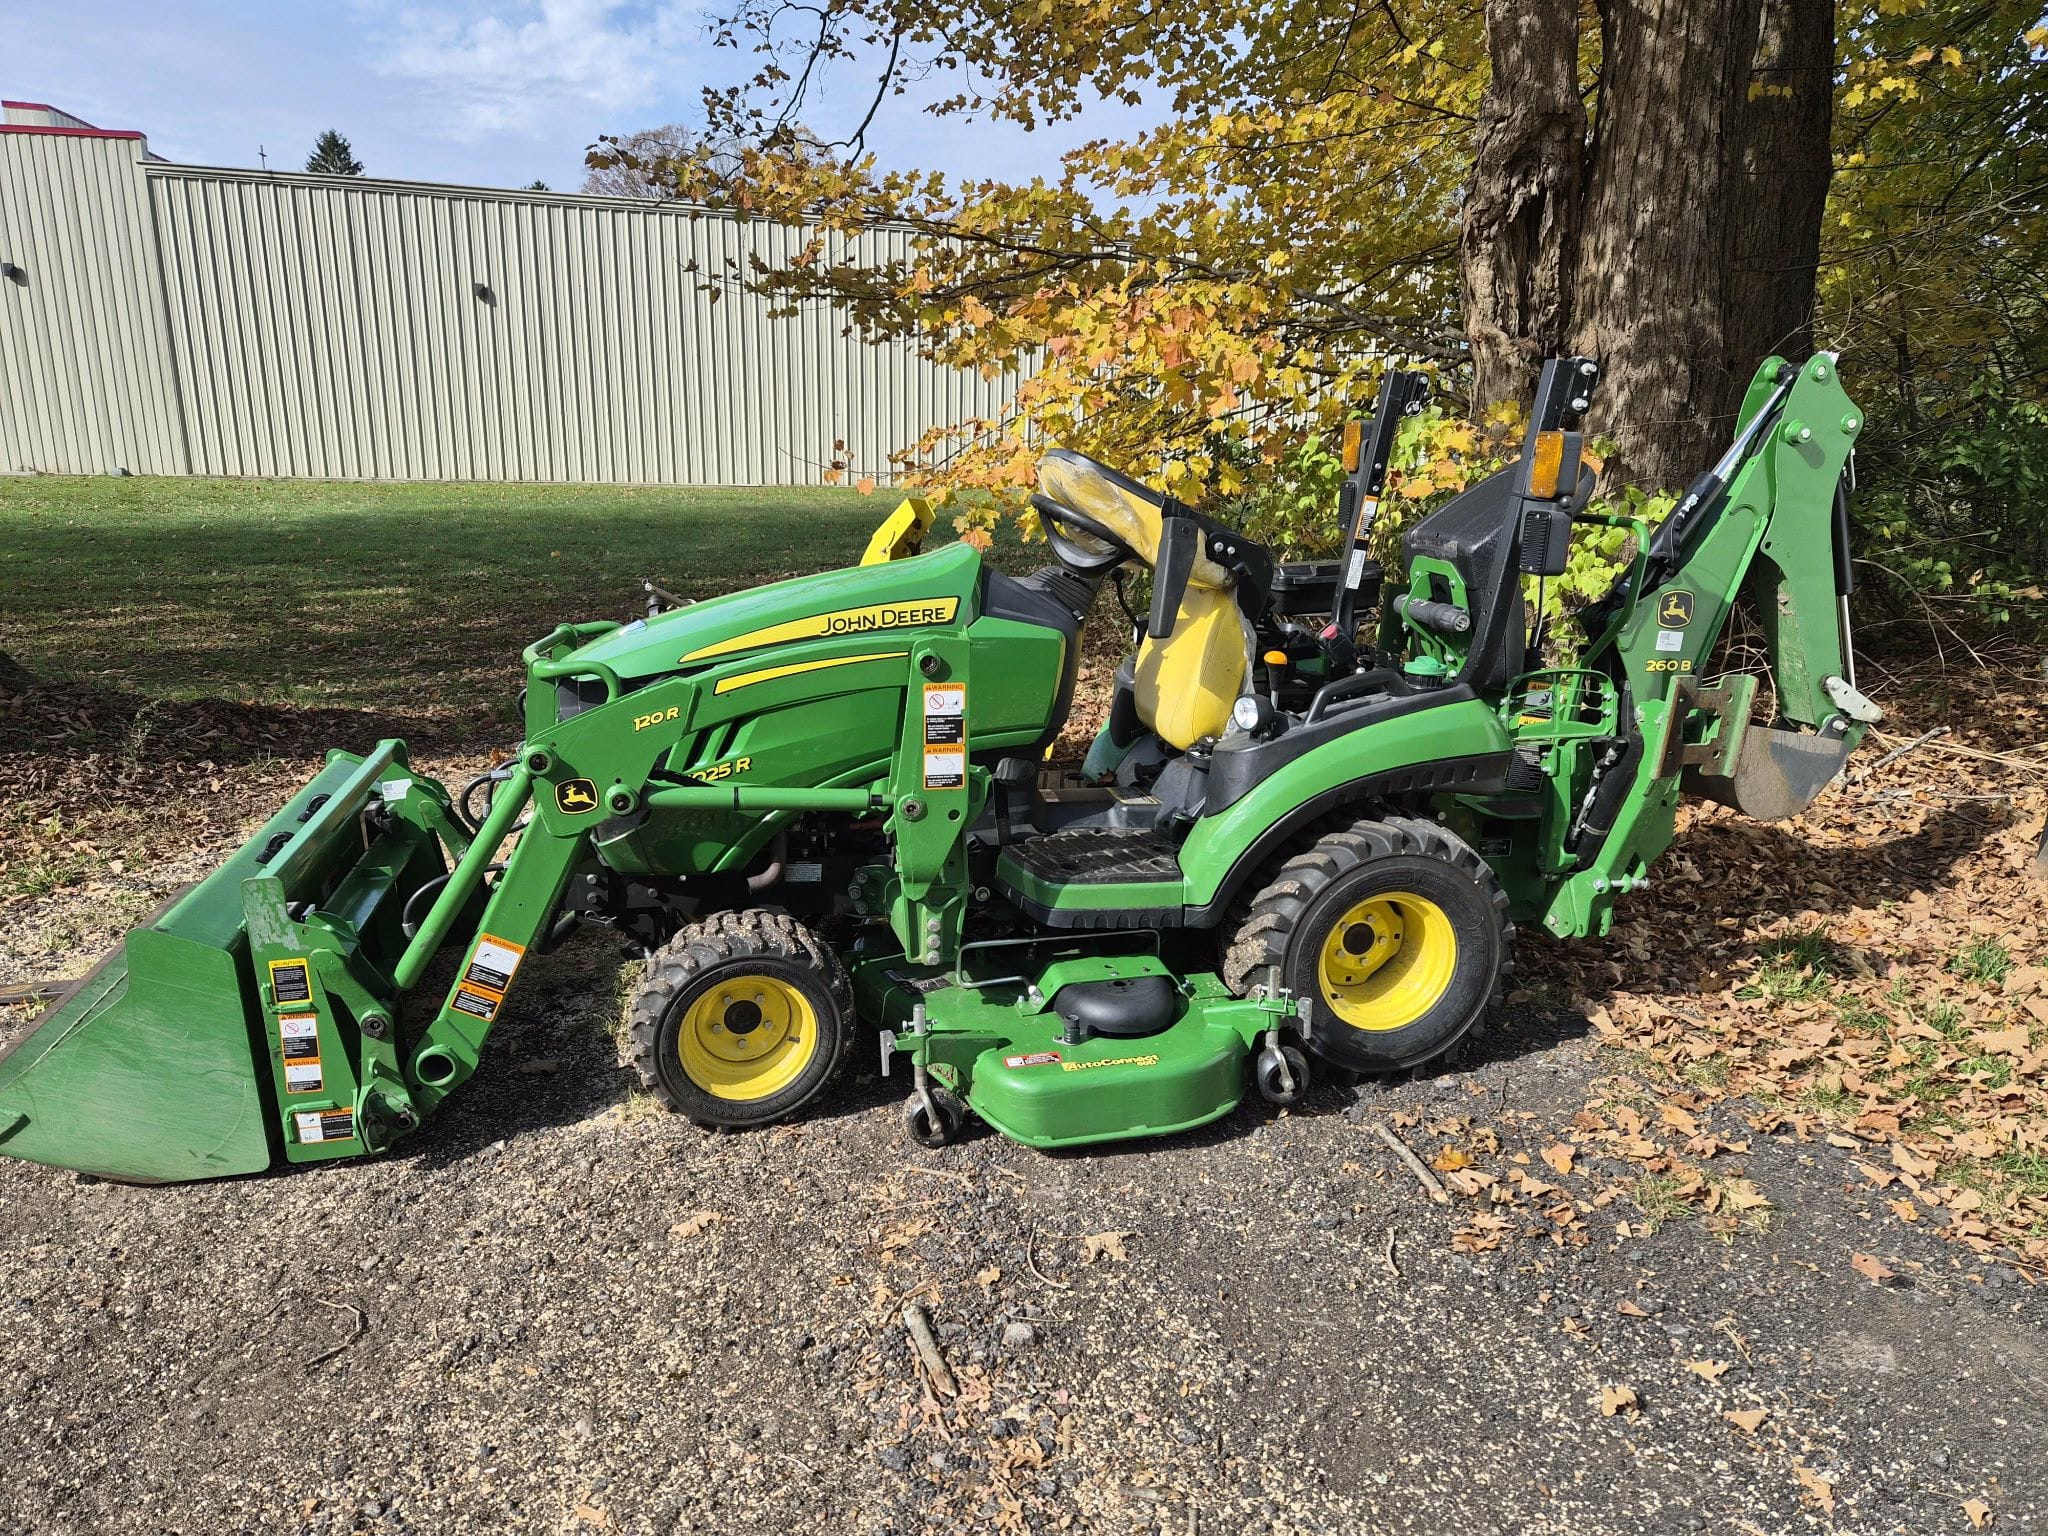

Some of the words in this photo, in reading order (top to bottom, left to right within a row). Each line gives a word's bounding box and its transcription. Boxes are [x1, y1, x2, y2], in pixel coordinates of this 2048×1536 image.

[820, 613, 876, 635] JOHN
[881, 607, 946, 626] DEERE
[1645, 659, 1679, 672] 260
[1680, 659, 1692, 672] B
[931, 683, 963, 691] WARNING
[633, 710, 665, 732] 120
[666, 706, 681, 721] R
[688, 762, 733, 782] 025
[735, 757, 752, 774] R
[1063, 1054, 1160, 1072] AutoConnect
